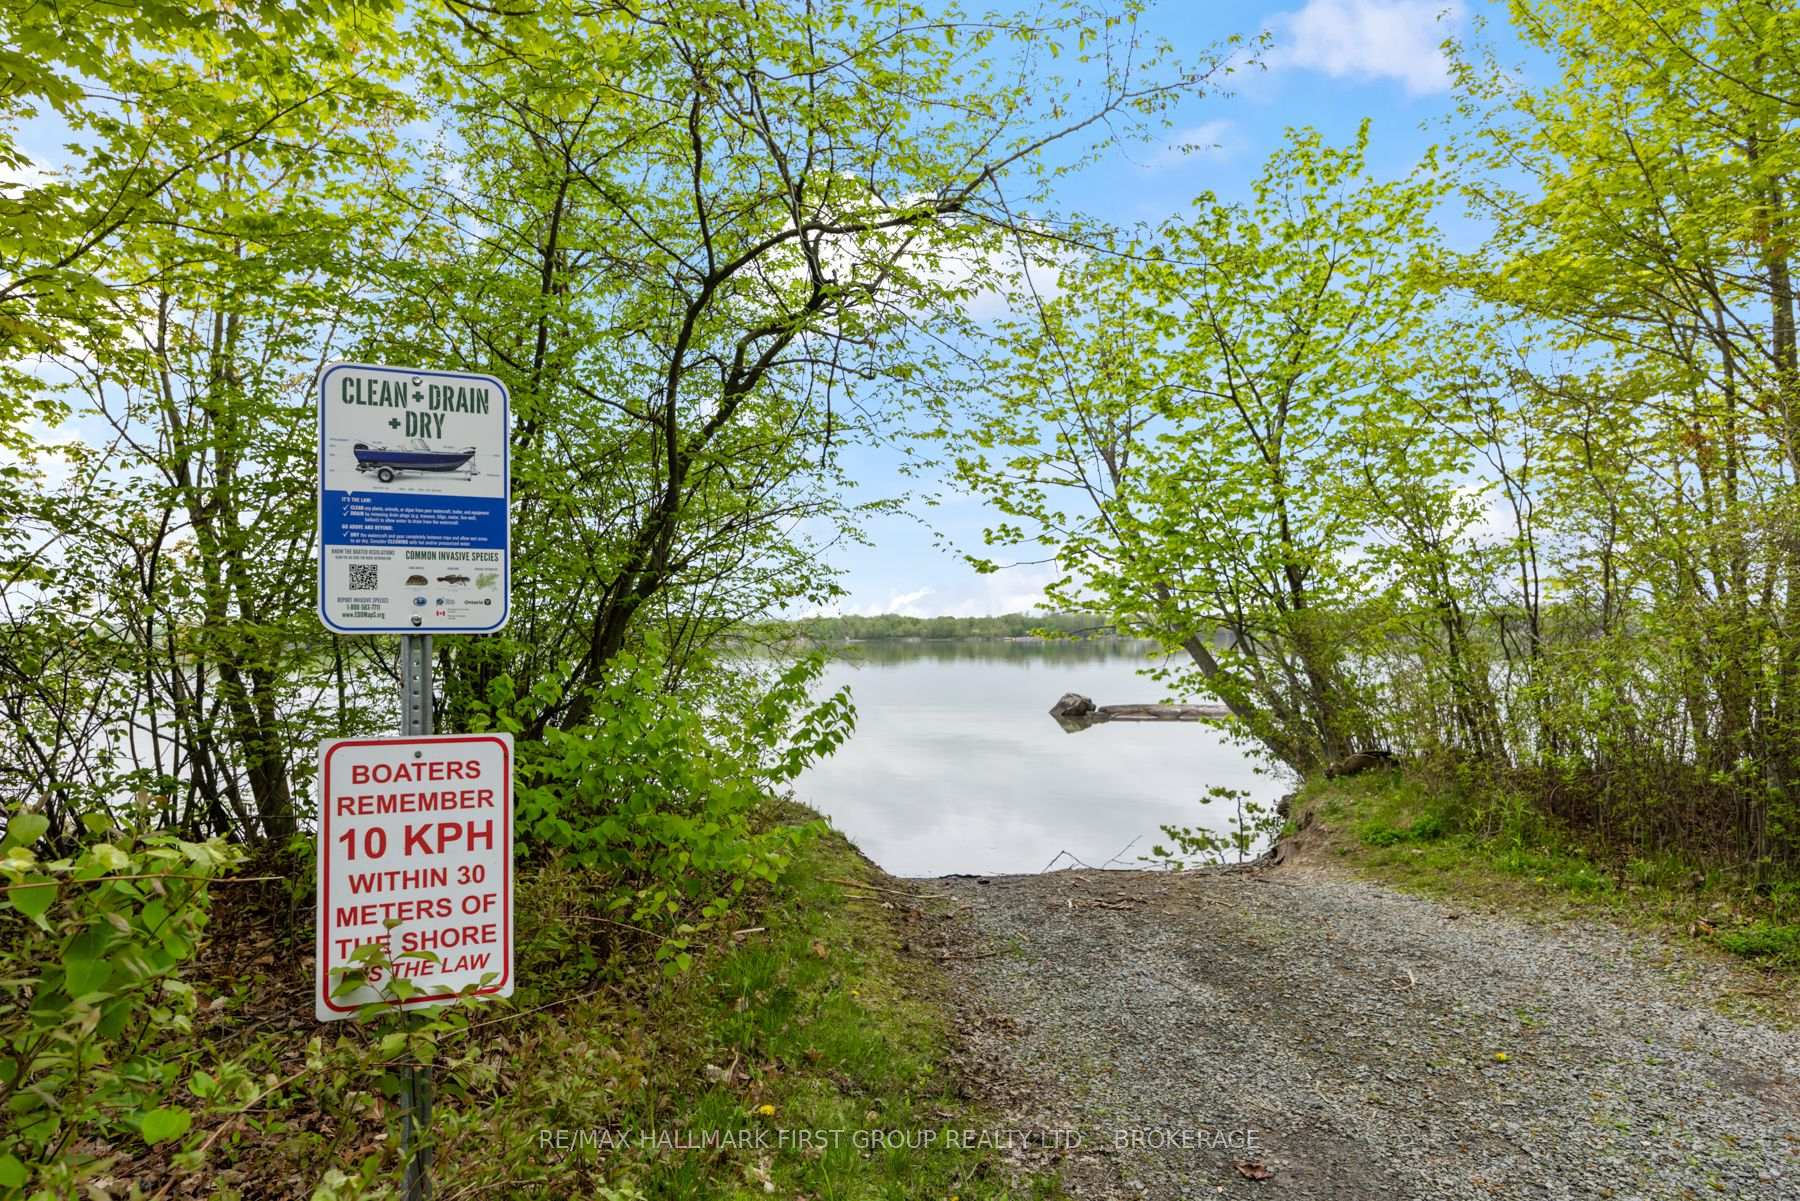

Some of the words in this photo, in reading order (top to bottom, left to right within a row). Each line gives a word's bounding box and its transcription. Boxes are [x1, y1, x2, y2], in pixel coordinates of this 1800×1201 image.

[341, 376, 408, 409] CLEAN
[428, 384, 489, 415] DRAIN
[405, 550, 437, 561] COMMON
[438, 551, 470, 561] INVASIVE
[471, 552, 499, 562] SPECIES
[352, 760, 482, 785] BOATERS
[337, 789, 494, 817] REMEMBER
[339, 827, 387, 861] 10
[404, 819, 493, 856] KPH
[348, 867, 448, 895] WITHIN
[457, 864, 486, 886] 30
[336, 898, 453, 928] METERS
[461, 893, 497, 915] OF
[401, 924, 497, 952] SHORE
[391, 959, 435, 978] THE
[441, 952, 491, 974] LAW
